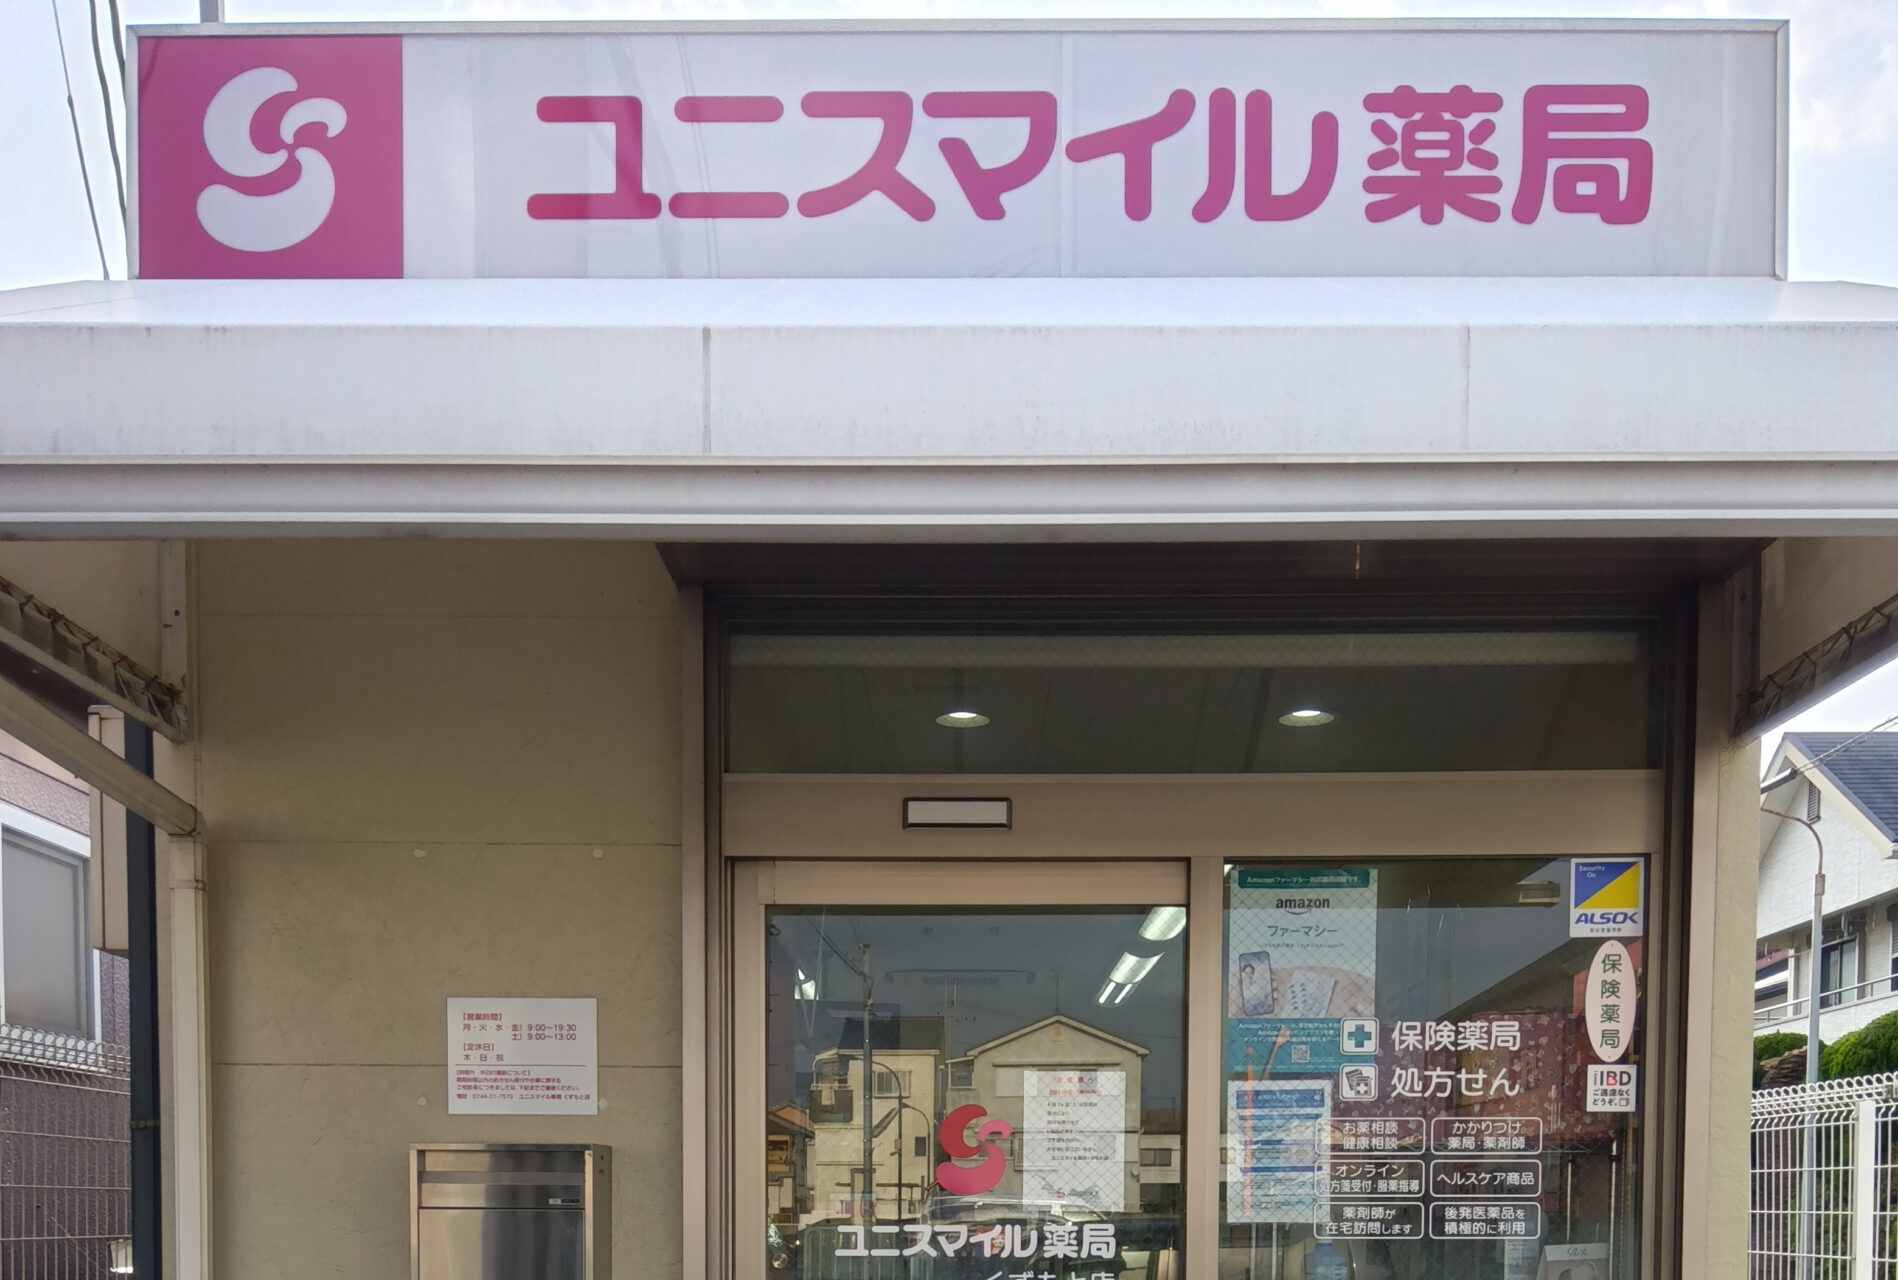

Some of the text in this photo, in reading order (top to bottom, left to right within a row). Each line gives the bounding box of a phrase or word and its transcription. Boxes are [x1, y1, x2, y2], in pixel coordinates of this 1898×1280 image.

[527, 84, 1653, 225] ユニスマイル薬局
[1276, 898, 1330, 909] amazon
[1575, 912, 1638, 925] ALSOK
[1267, 925, 1338, 937] ファーマシー
[1599, 953, 1623, 1049] 保険薬局
[1391, 1020, 1521, 1051] 保険薬局
[1391, 1066, 1521, 1098] 処方せん
[1600, 1071, 1632, 1086] IBD
[1342, 1121, 1399, 1134] お薬相談
[1452, 1121, 1522, 1134] かかりつけ
[1343, 1137, 1399, 1150] 健康相談
[1447, 1137, 1525, 1150] 薬局・薬剤師
[1335, 1164, 1405, 1178] オンライン
[1436, 1172, 1535, 1185] ヘルスケア商品
[1342, 1207, 1396, 1219] 薬剤師が
[1444, 1207, 1526, 1219] 後発医薬品を
[1325, 1221, 1413, 1235] 在宅訪問します
[1444, 1222, 1526, 1235] 積極的に利用
[835, 1223, 1116, 1259] ユニスマイル薬局
